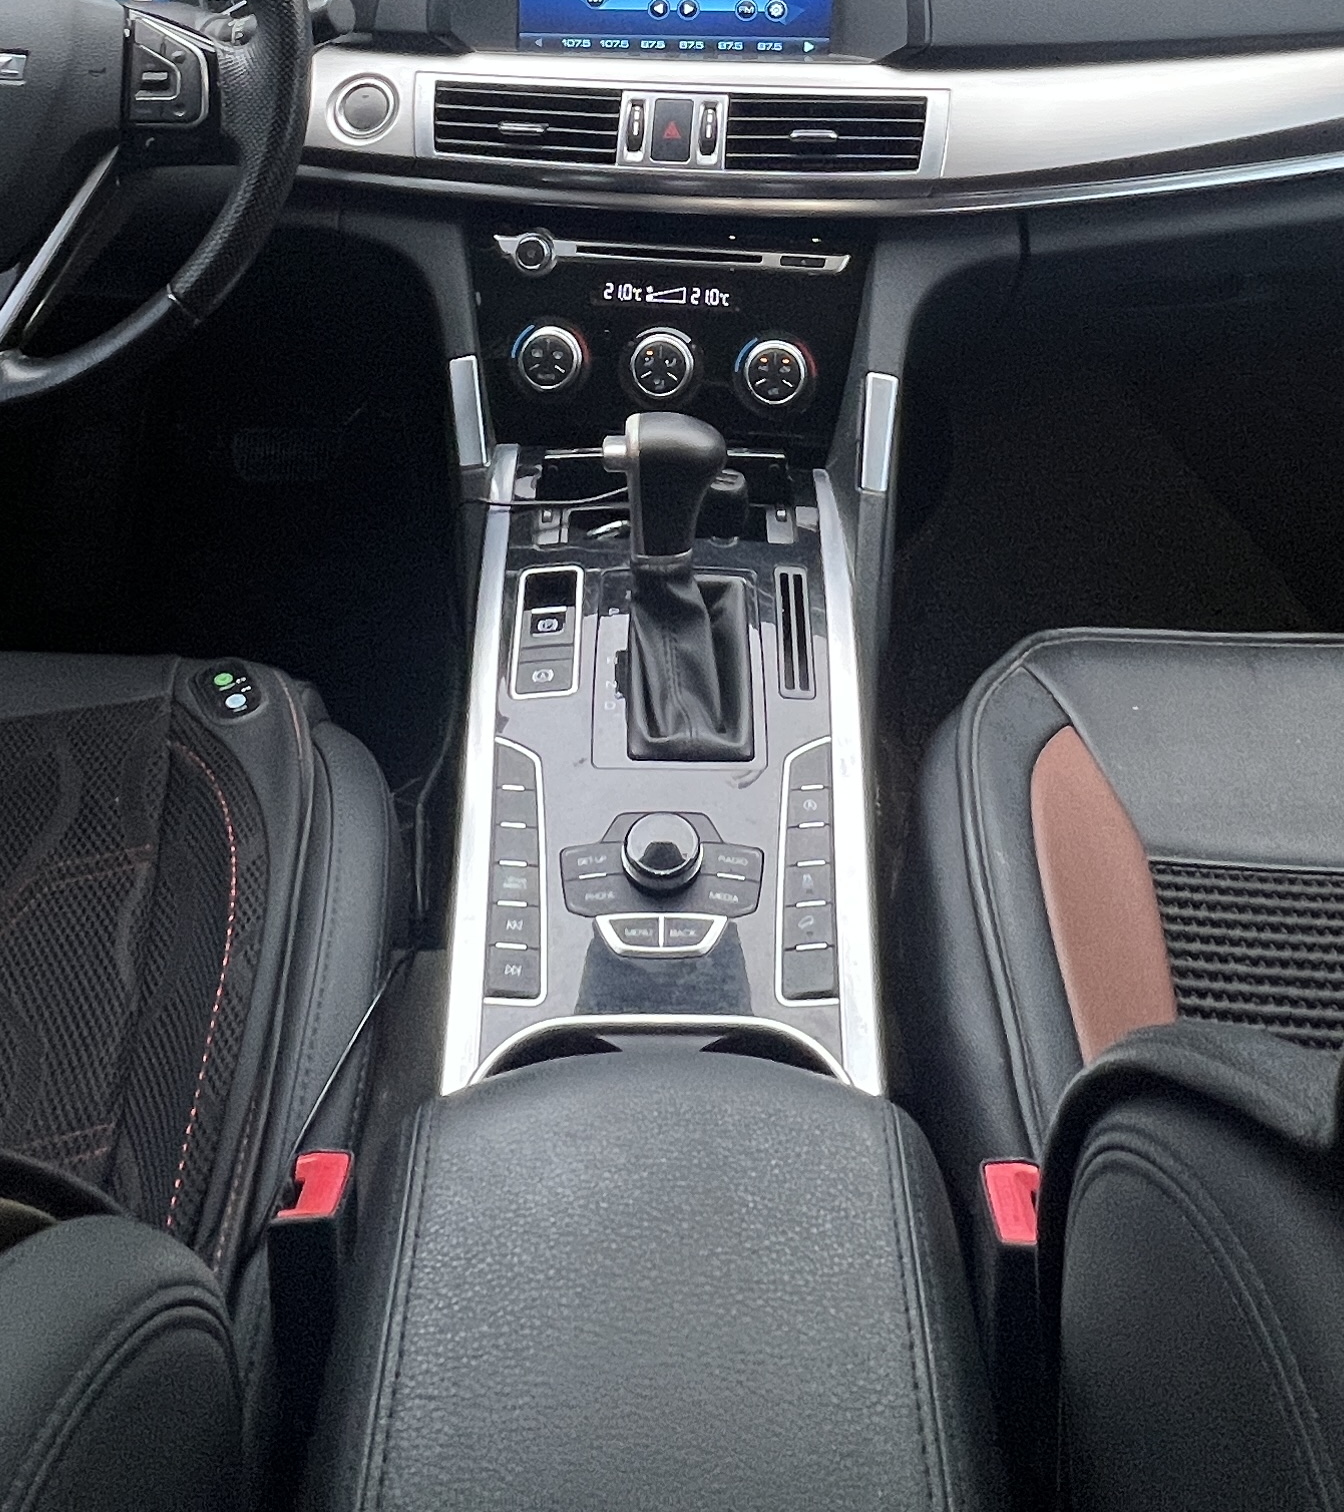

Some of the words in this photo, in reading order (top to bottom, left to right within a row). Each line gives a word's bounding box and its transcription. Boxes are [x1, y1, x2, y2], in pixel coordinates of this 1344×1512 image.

[717, 854, 748, 866] RADIO
[708, 891, 739, 903] MEDIA
[669, 928, 696, 937] BACK
